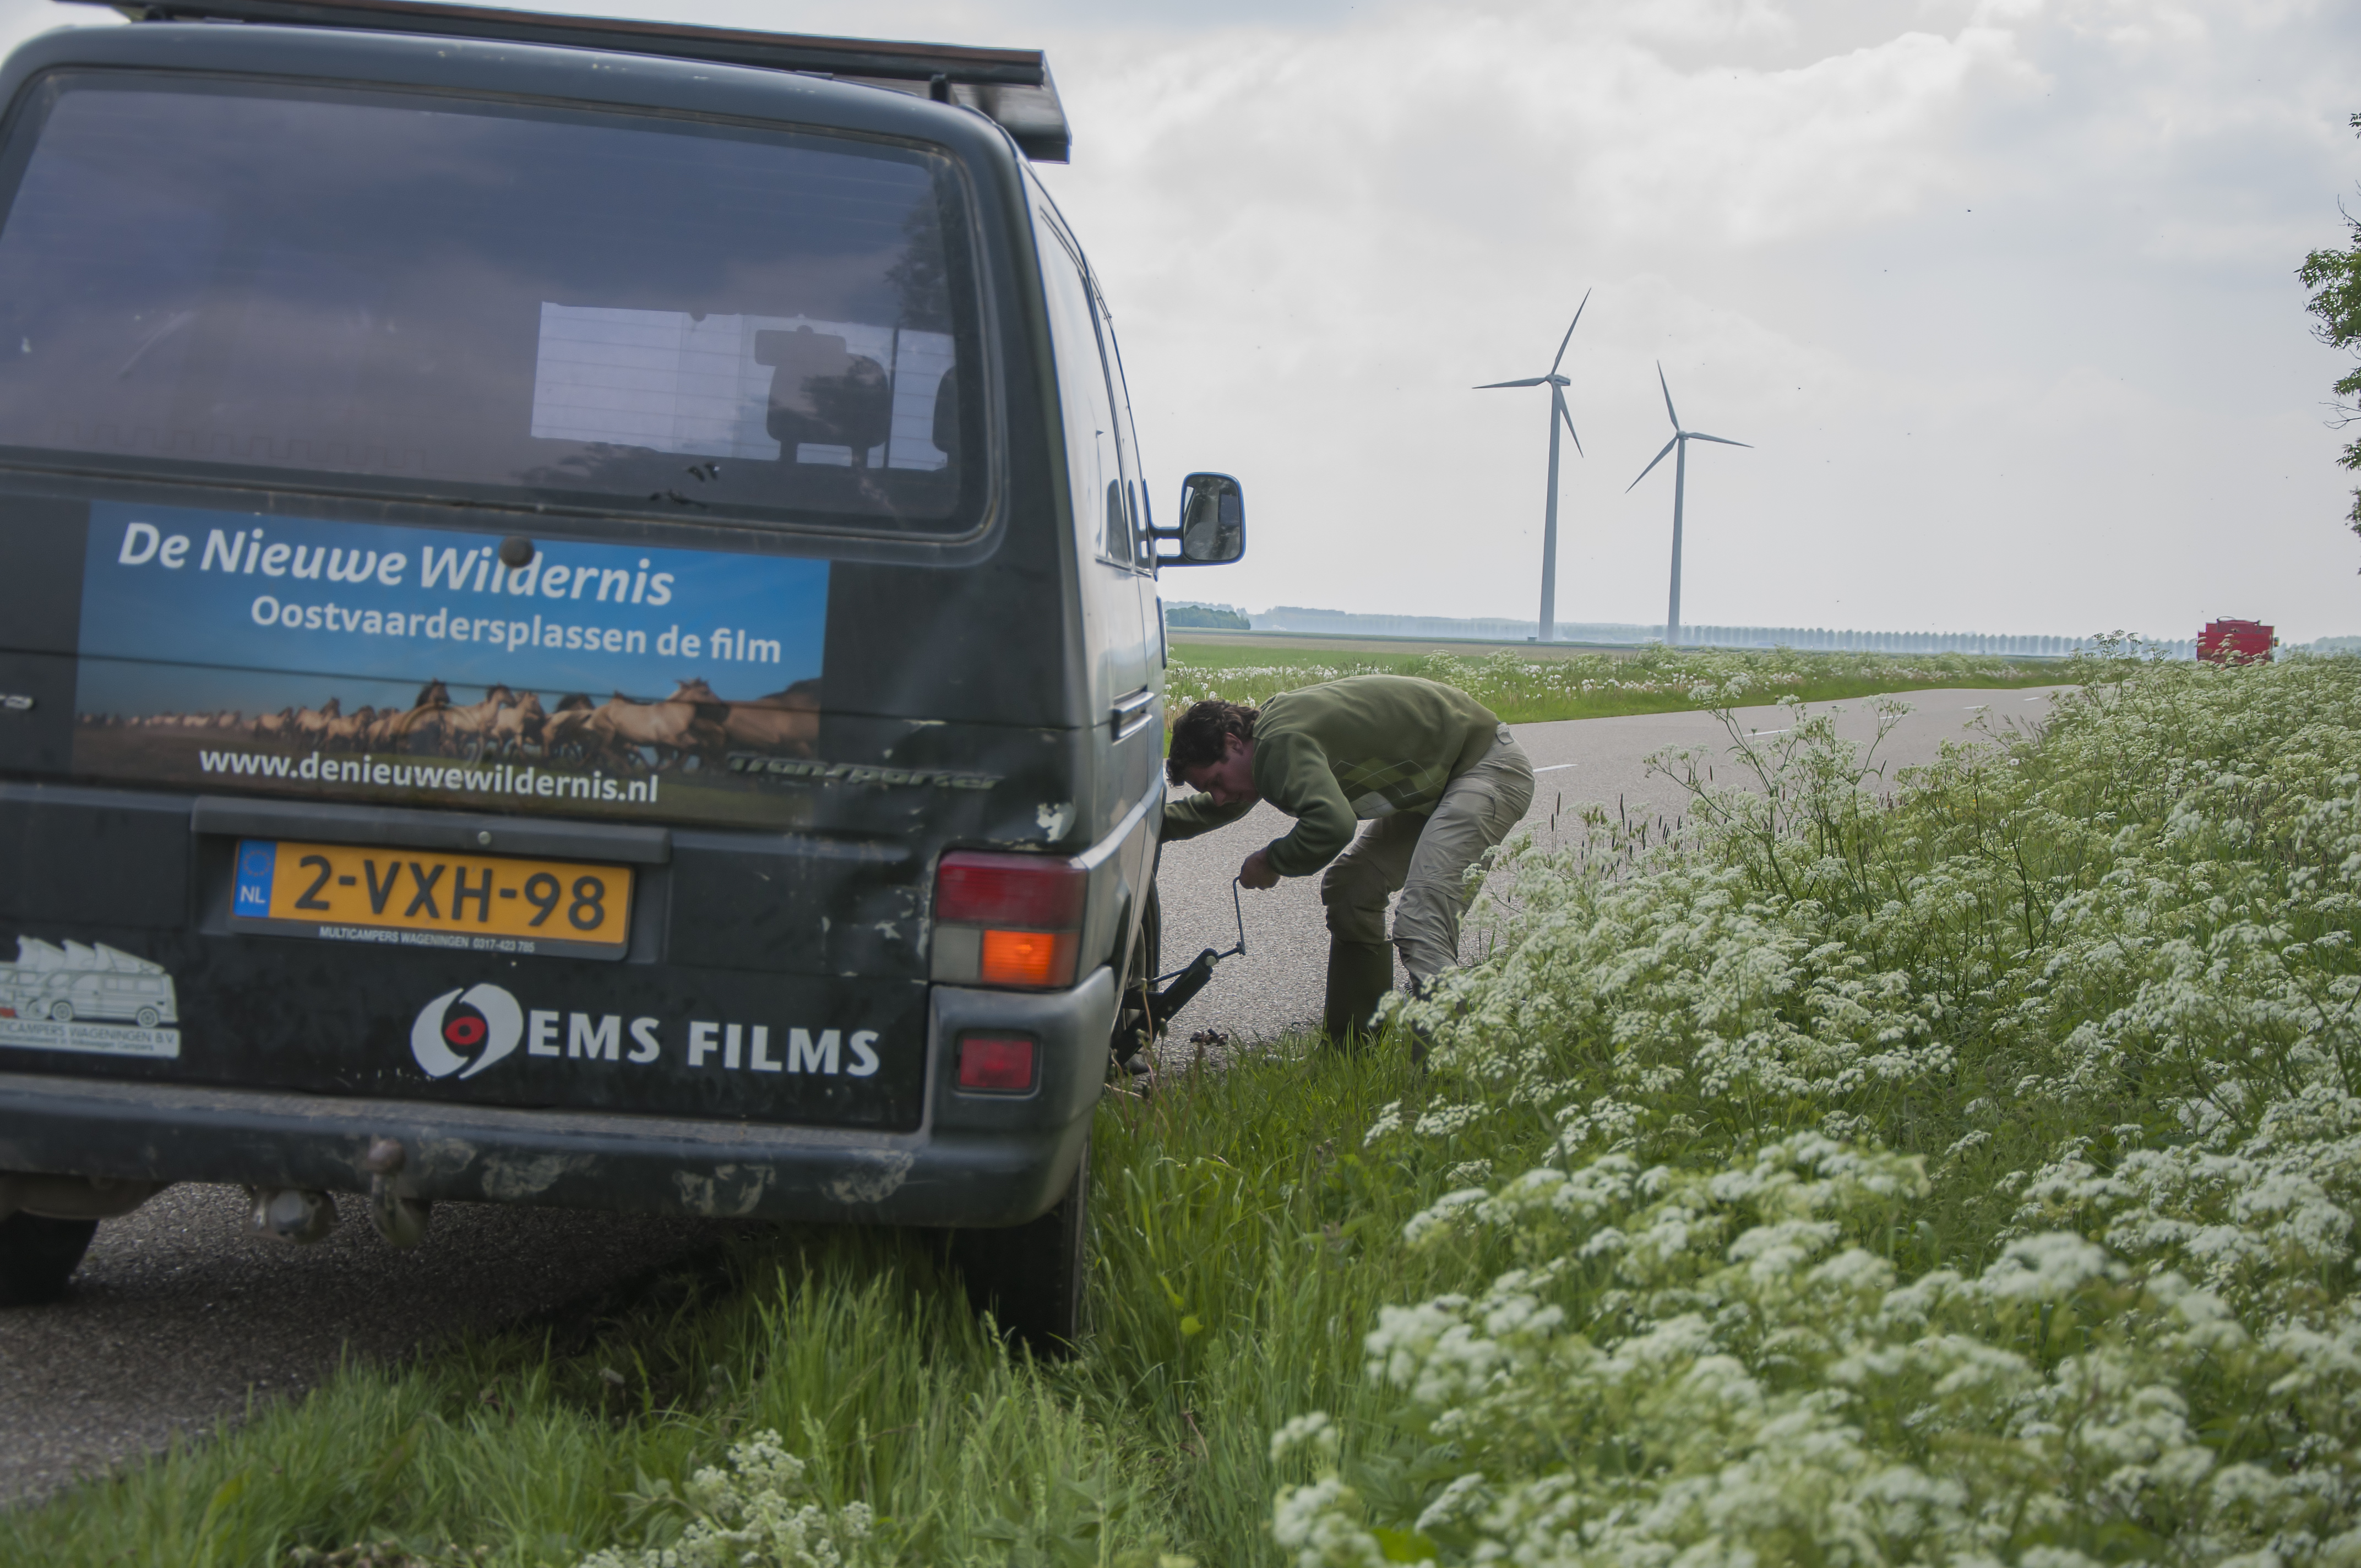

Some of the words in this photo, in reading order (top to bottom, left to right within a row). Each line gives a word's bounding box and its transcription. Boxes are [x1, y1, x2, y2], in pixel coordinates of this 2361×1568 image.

[117, 521, 190, 569] De
[199, 527, 407, 586] Nieuwe
[420, 546, 676, 606] Wildernis
[251, 595, 647, 654] Oostvaardersplassen
[656, 624, 701, 658] de
[710, 627, 782, 663] film
[199, 749, 659, 803] www.denieuwewildernis.nl
[240, 885, 266, 904] NL
[294, 854, 605, 931] 2-VXH-98
[319, 926, 399, 943] MULTICAMPERS
[401, 932, 469, 949] WAGENINGEN
[529, 1009, 660, 1064] EMS
[687, 1020, 880, 1077] FILMS
